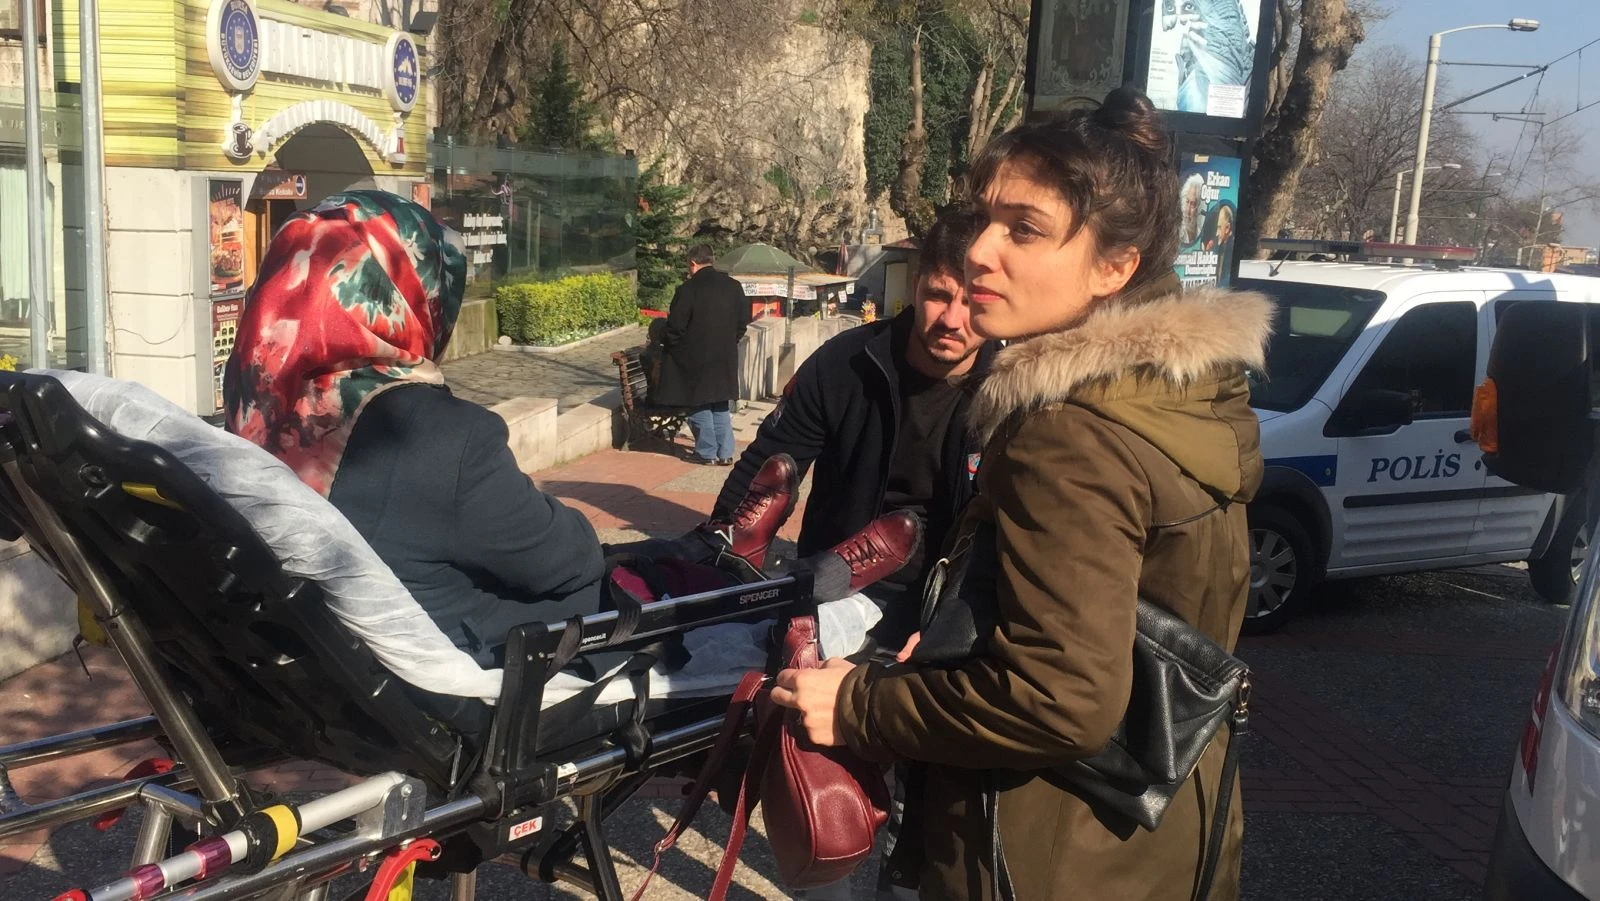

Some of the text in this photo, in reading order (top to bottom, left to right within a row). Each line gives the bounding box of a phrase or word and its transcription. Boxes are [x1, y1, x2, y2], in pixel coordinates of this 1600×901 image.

[1207, 170, 1230, 188] Erkan
[1367, 448, 1461, 483] POLİS
[739, 588, 779, 605] SPENCER
[513, 820, 537, 837] ÇEK
